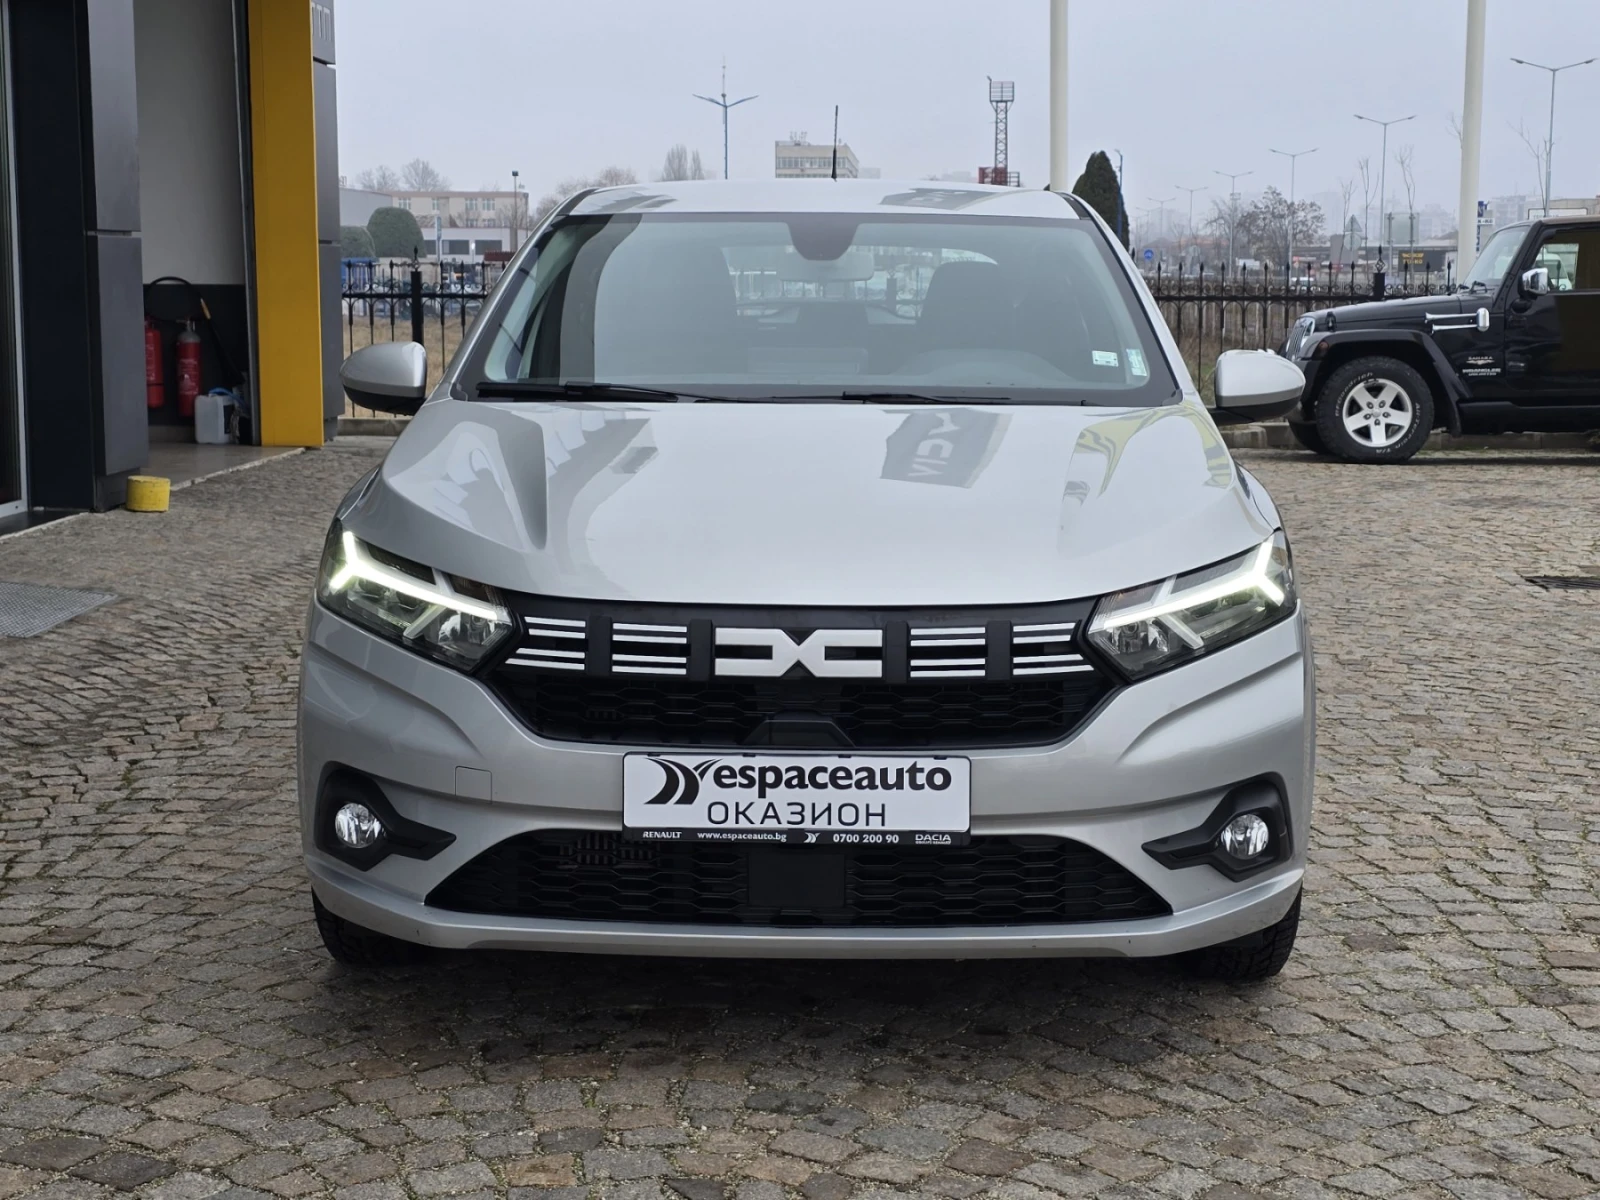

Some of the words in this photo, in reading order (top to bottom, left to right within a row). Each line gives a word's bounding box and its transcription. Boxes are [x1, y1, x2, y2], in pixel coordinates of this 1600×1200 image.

[713, 760, 952, 799] espaceauto
[707, 801, 886, 827] ОКАЗИОН
[642, 831, 683, 839] RENAULT
[697, 831, 787, 843] www.espaceauto.bg
[833, 833, 860, 844] 0700
[862, 833, 883, 844] 200
[885, 834, 900, 844] 90
